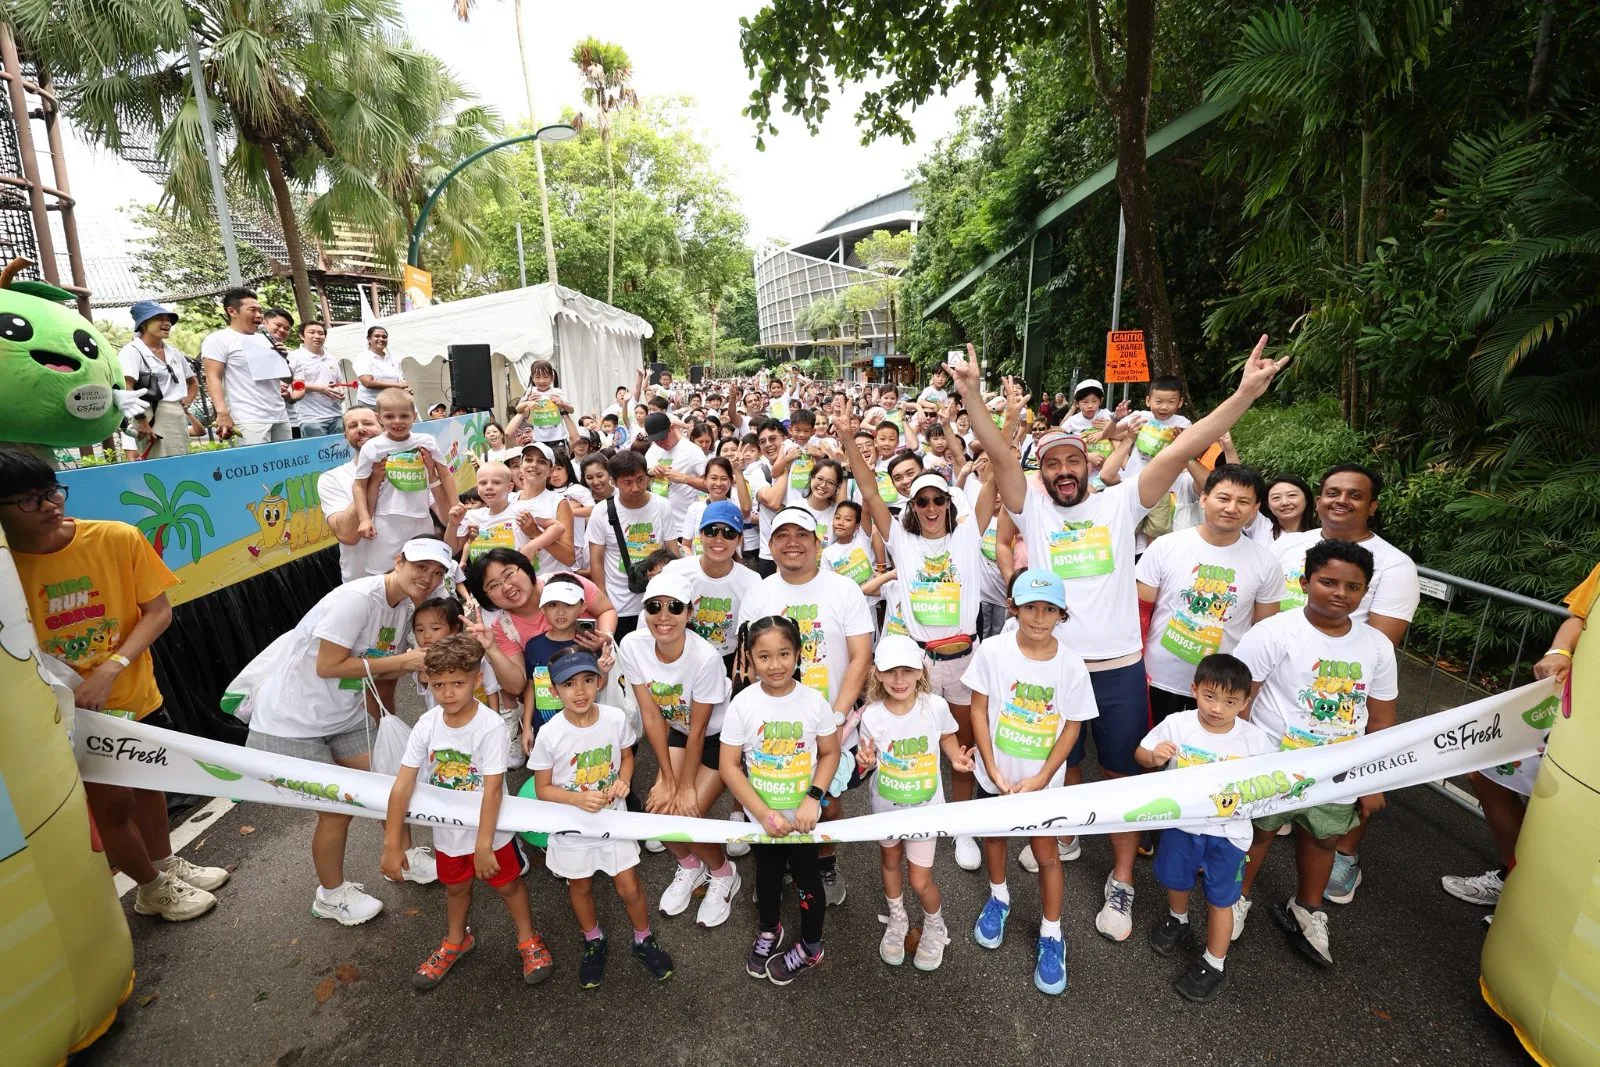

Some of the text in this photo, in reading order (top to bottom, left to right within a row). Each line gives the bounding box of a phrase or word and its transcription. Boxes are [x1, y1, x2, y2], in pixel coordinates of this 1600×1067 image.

[1113, 333, 1143, 342] CAUTIO
[318, 448, 330, 460] CS
[225, 454, 311, 480] COLD STORAGE
[1198, 564, 1236, 584] KIDS
[48, 591, 89, 614] RUN
[45, 604, 106, 631] CREW
[1318, 659, 1364, 680] KIDS
[764, 721, 804, 740] KIDS
[999, 726, 1043, 748] C51246-2
[1434, 712, 1502, 751] CS Fresh
[86, 735, 168, 767] CS Fresh
[893, 735, 929, 757] KIDS
[1348, 751, 1418, 780] STORAGE
[752, 777, 796, 794] C51066-2
[880, 775, 921, 791] C51246-3
[1236, 769, 1291, 805] KIDS
